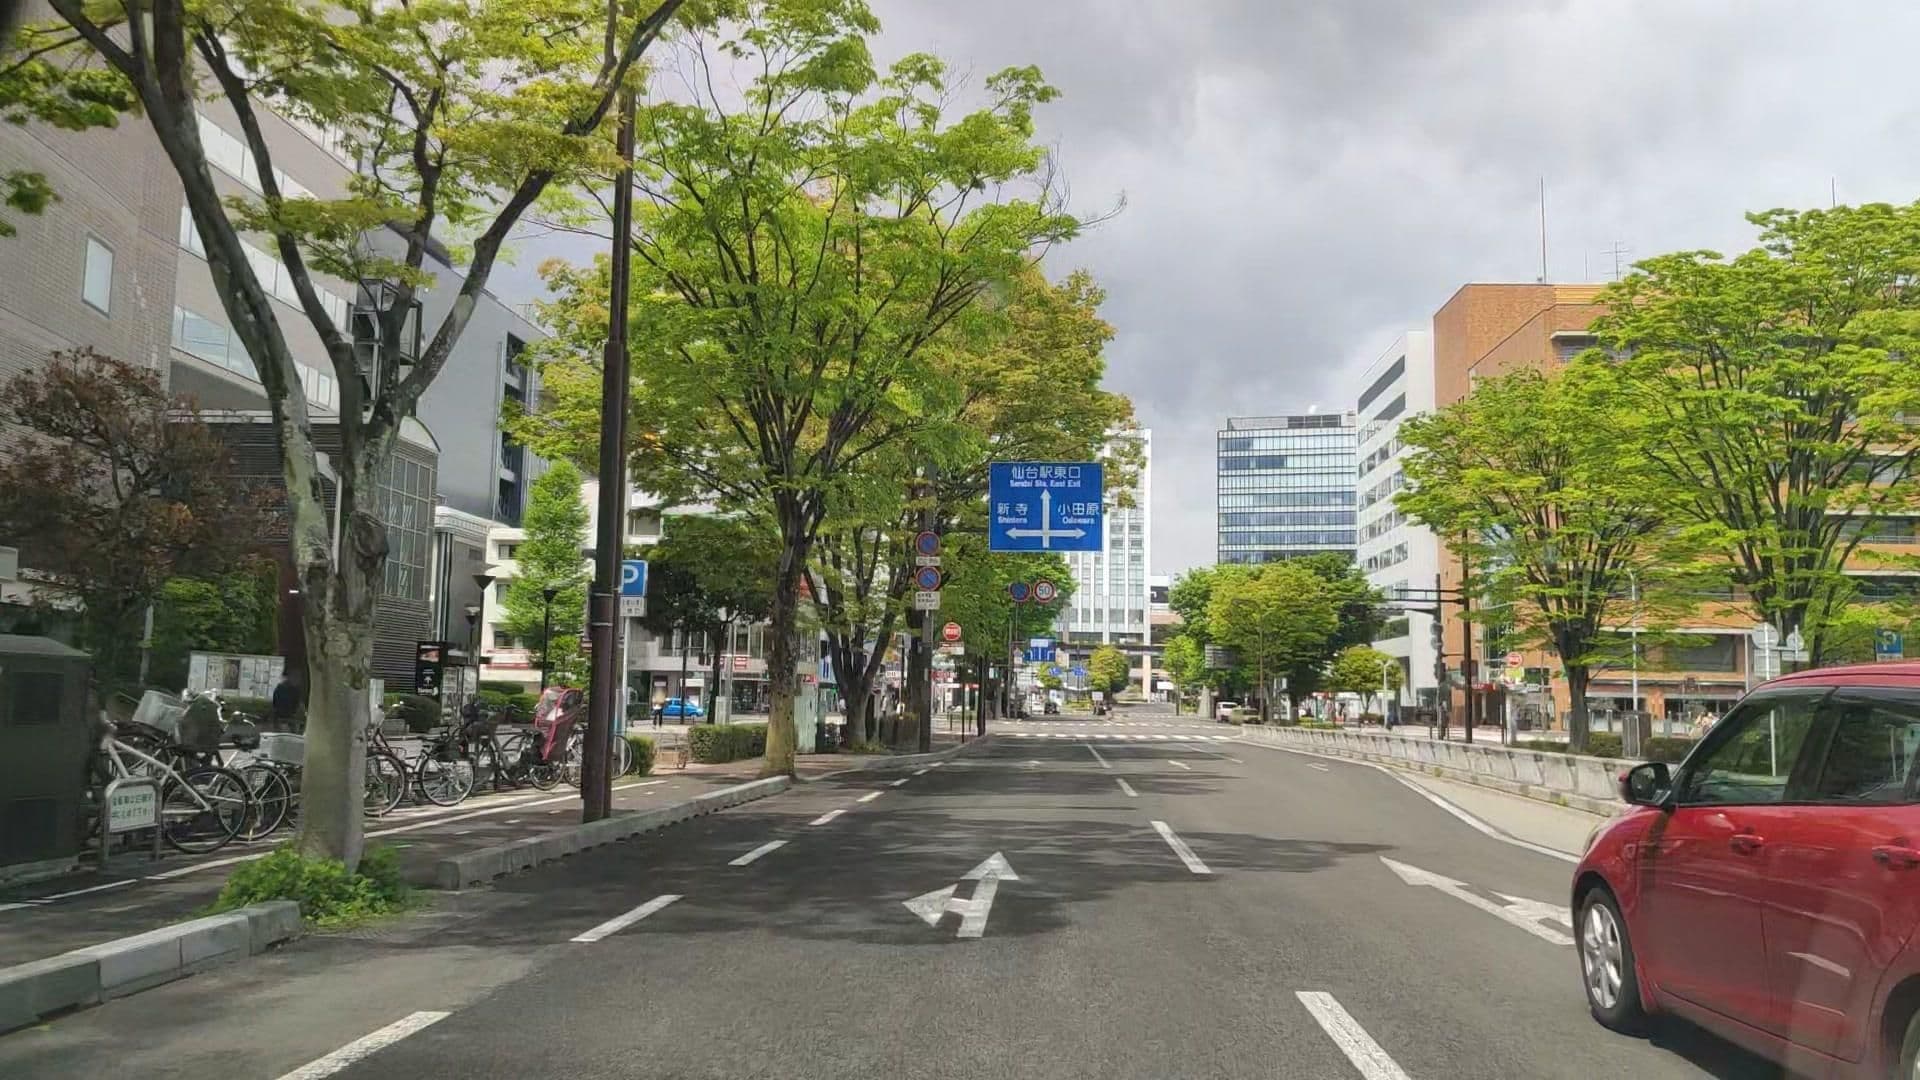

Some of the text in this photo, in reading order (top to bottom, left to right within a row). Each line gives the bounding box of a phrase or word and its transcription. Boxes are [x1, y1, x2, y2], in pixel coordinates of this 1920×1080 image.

[1012, 466, 1081, 479] 仙台駅東口
[1034, 480, 1048, 488] Sta.
[1057, 503, 1100, 515] 小田原
[622, 565, 639, 592] P
[1039, 586, 1051, 595] 50
[1883, 631, 1897, 651] P
